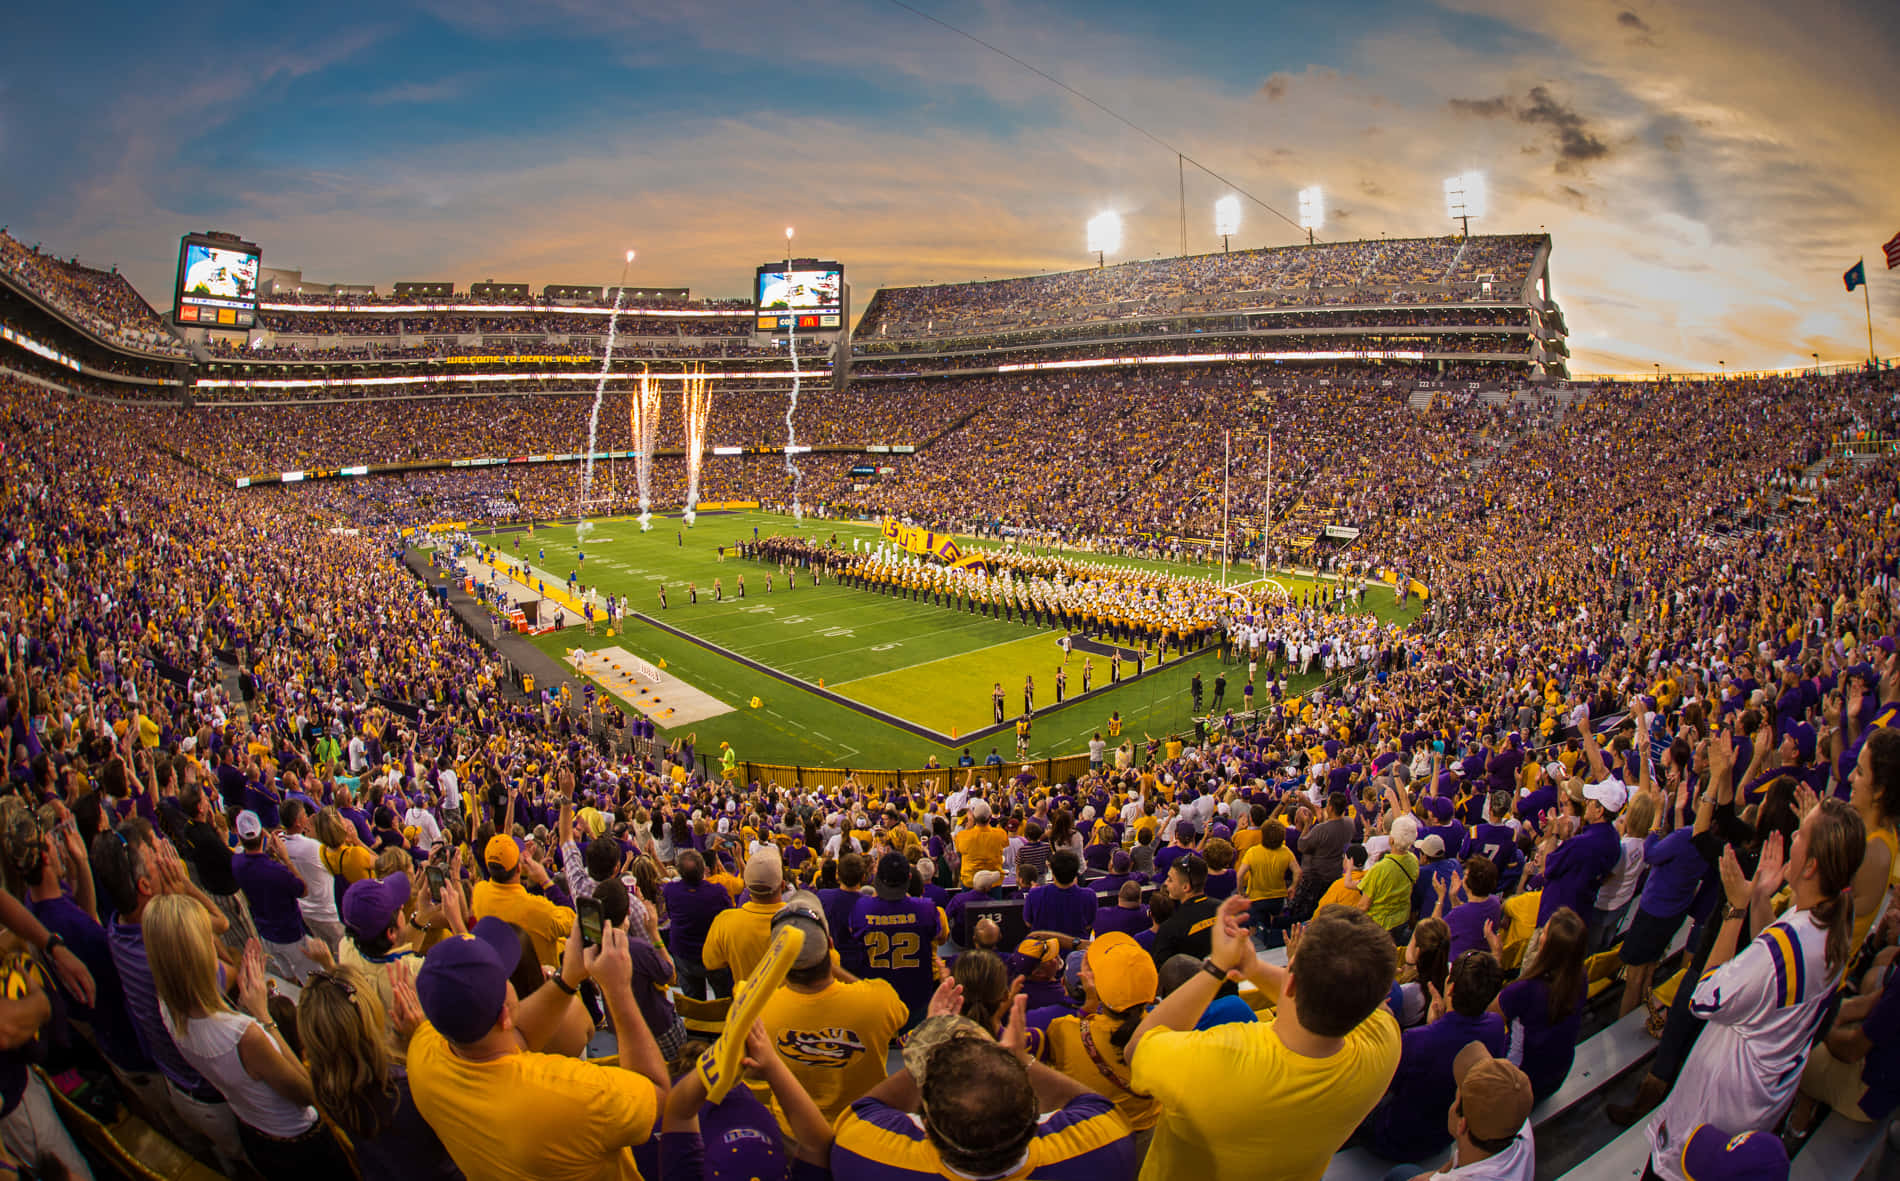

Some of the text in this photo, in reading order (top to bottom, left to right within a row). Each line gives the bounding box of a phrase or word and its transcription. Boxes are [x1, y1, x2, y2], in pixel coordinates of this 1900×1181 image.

[446, 355, 592, 364] WELCOME TO DEATH VALLEY
[1483, 843, 1500, 863] 7
[865, 913, 917, 926] TIGERS
[864, 931, 920, 970] 22
